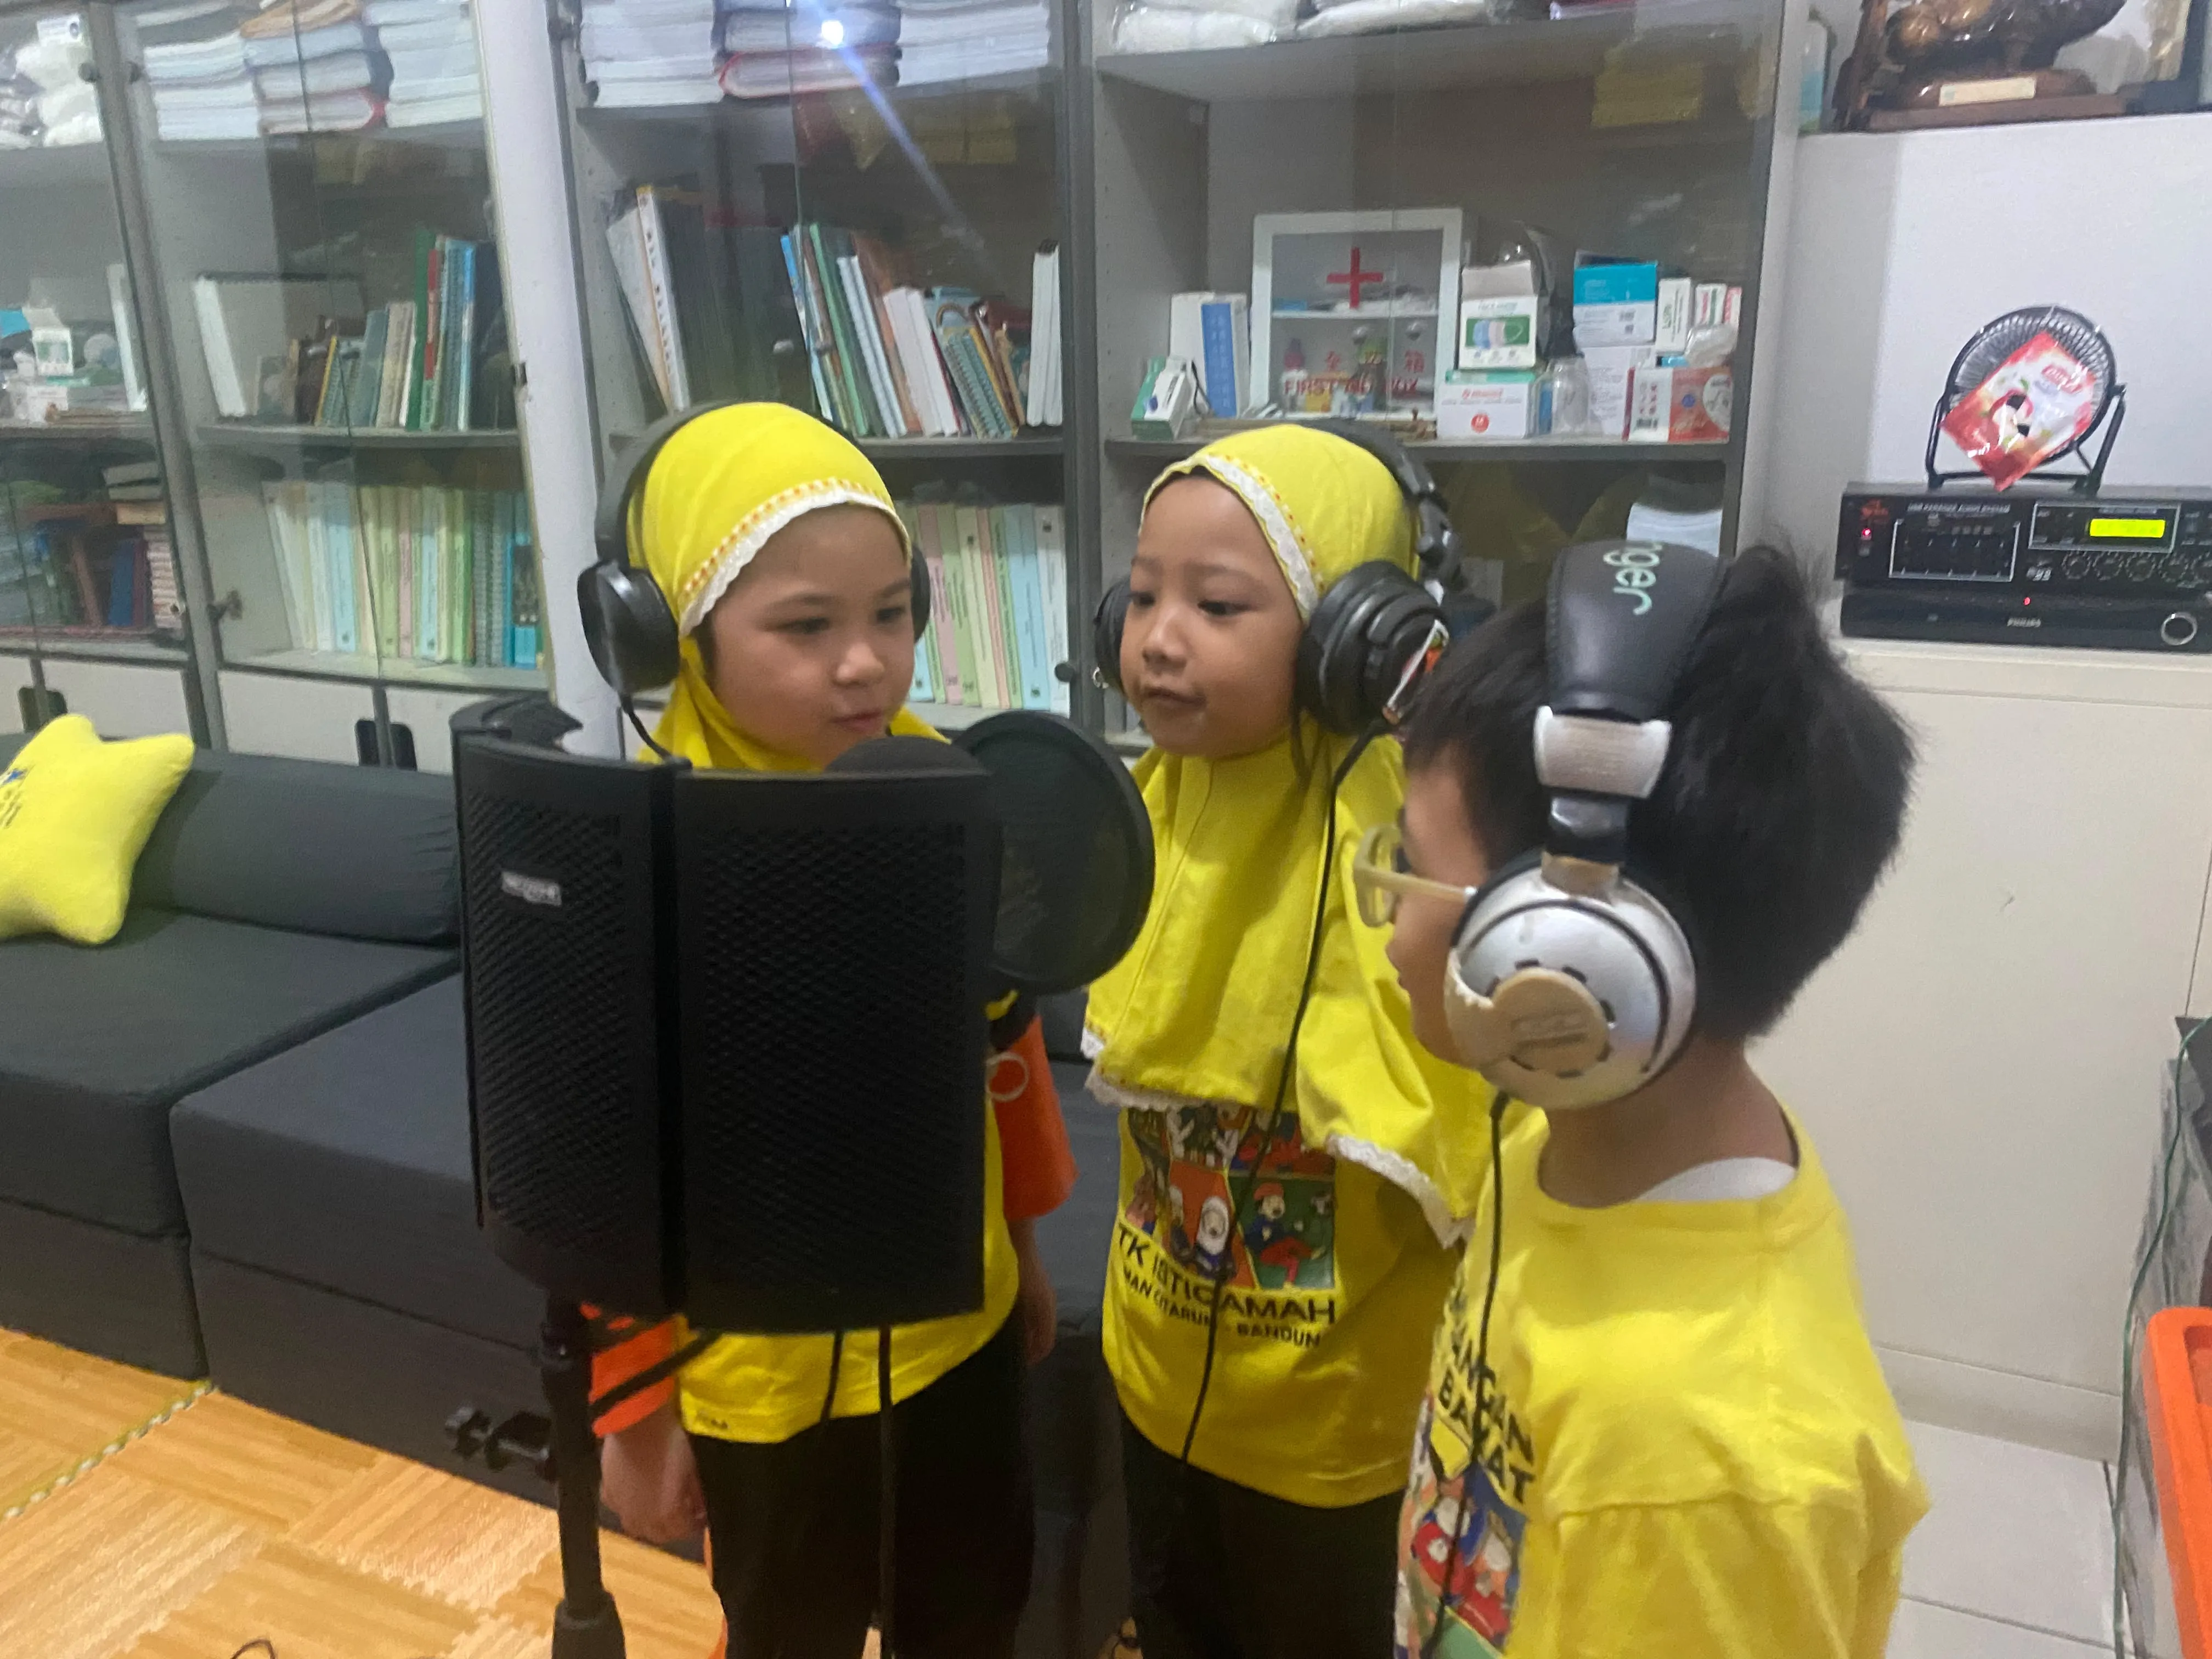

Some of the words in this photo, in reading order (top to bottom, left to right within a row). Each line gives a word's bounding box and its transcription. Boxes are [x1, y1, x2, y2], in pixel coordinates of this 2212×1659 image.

[1602, 540, 1663, 616] ger
[1119, 1222, 1150, 1266] TK
[1237, 1322, 1321, 1347] BANDUN
